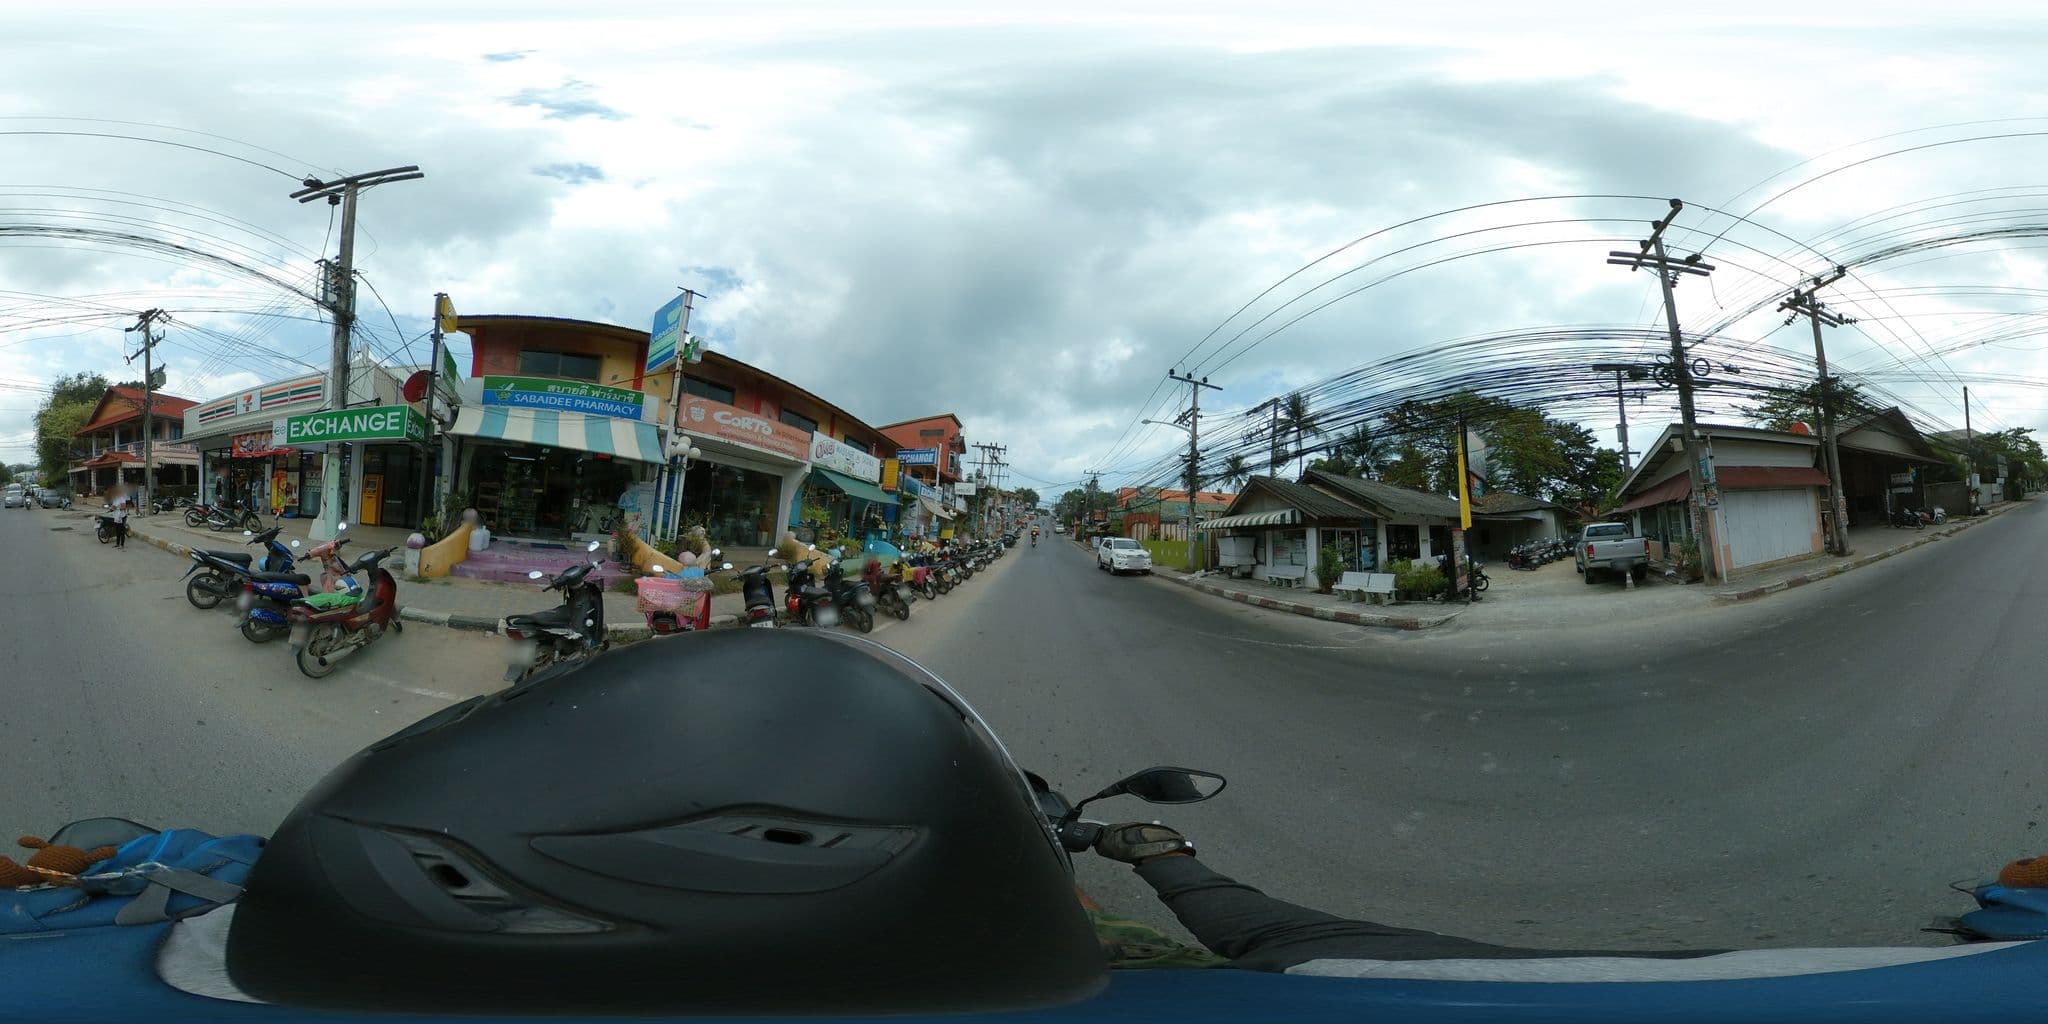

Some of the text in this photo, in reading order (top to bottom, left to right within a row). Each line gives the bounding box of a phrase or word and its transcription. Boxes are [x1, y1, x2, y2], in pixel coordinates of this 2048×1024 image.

[514, 393, 636, 415] SABAIDEE PHARMACY
[290, 411, 401, 438] EXCHANGE
